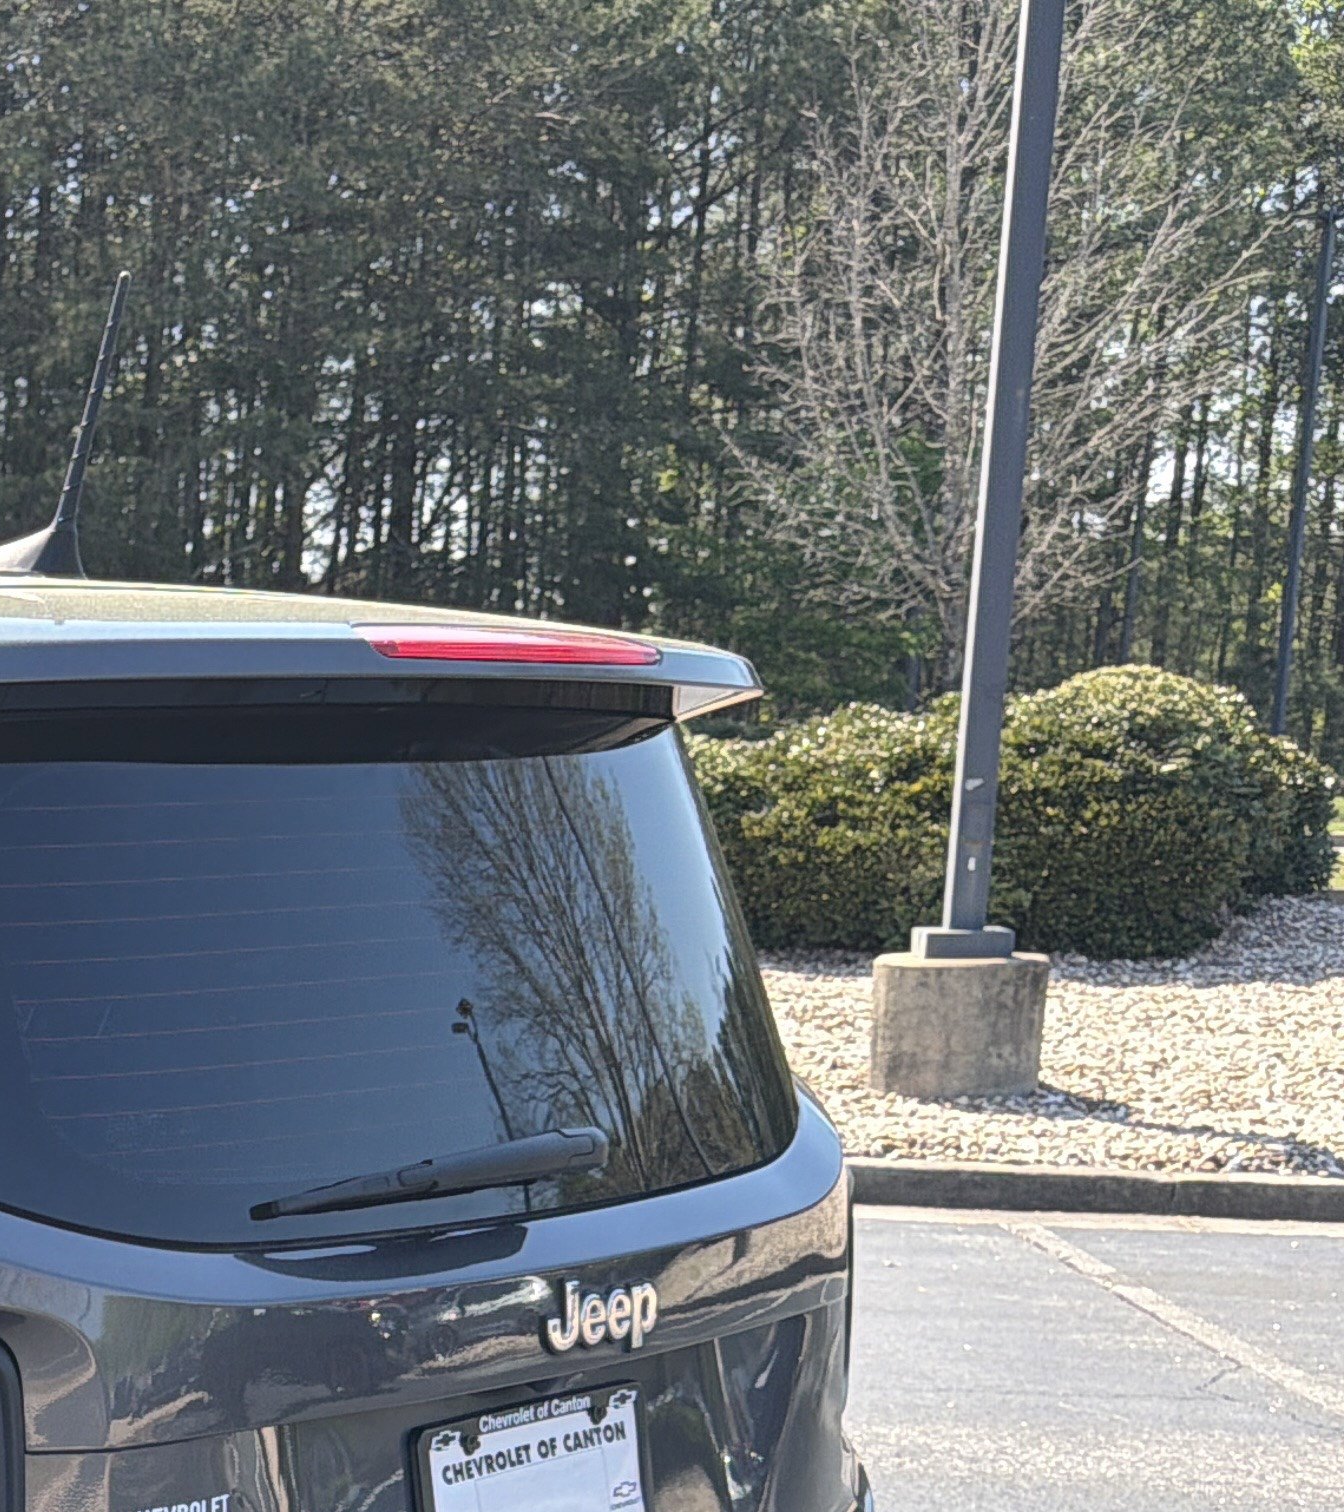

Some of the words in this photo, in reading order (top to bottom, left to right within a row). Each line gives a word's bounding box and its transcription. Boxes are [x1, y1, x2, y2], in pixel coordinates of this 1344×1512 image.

[545, 1279, 658, 1351] Jeep
[478, 1405, 536, 1433] Chevrolet
[536, 1401, 549, 1419] of
[550, 1394, 591, 1416] Canton
[441, 1443, 532, 1486] CHEVROLET
[536, 1437, 558, 1459] OF
[562, 1420, 627, 1453] CANTON
